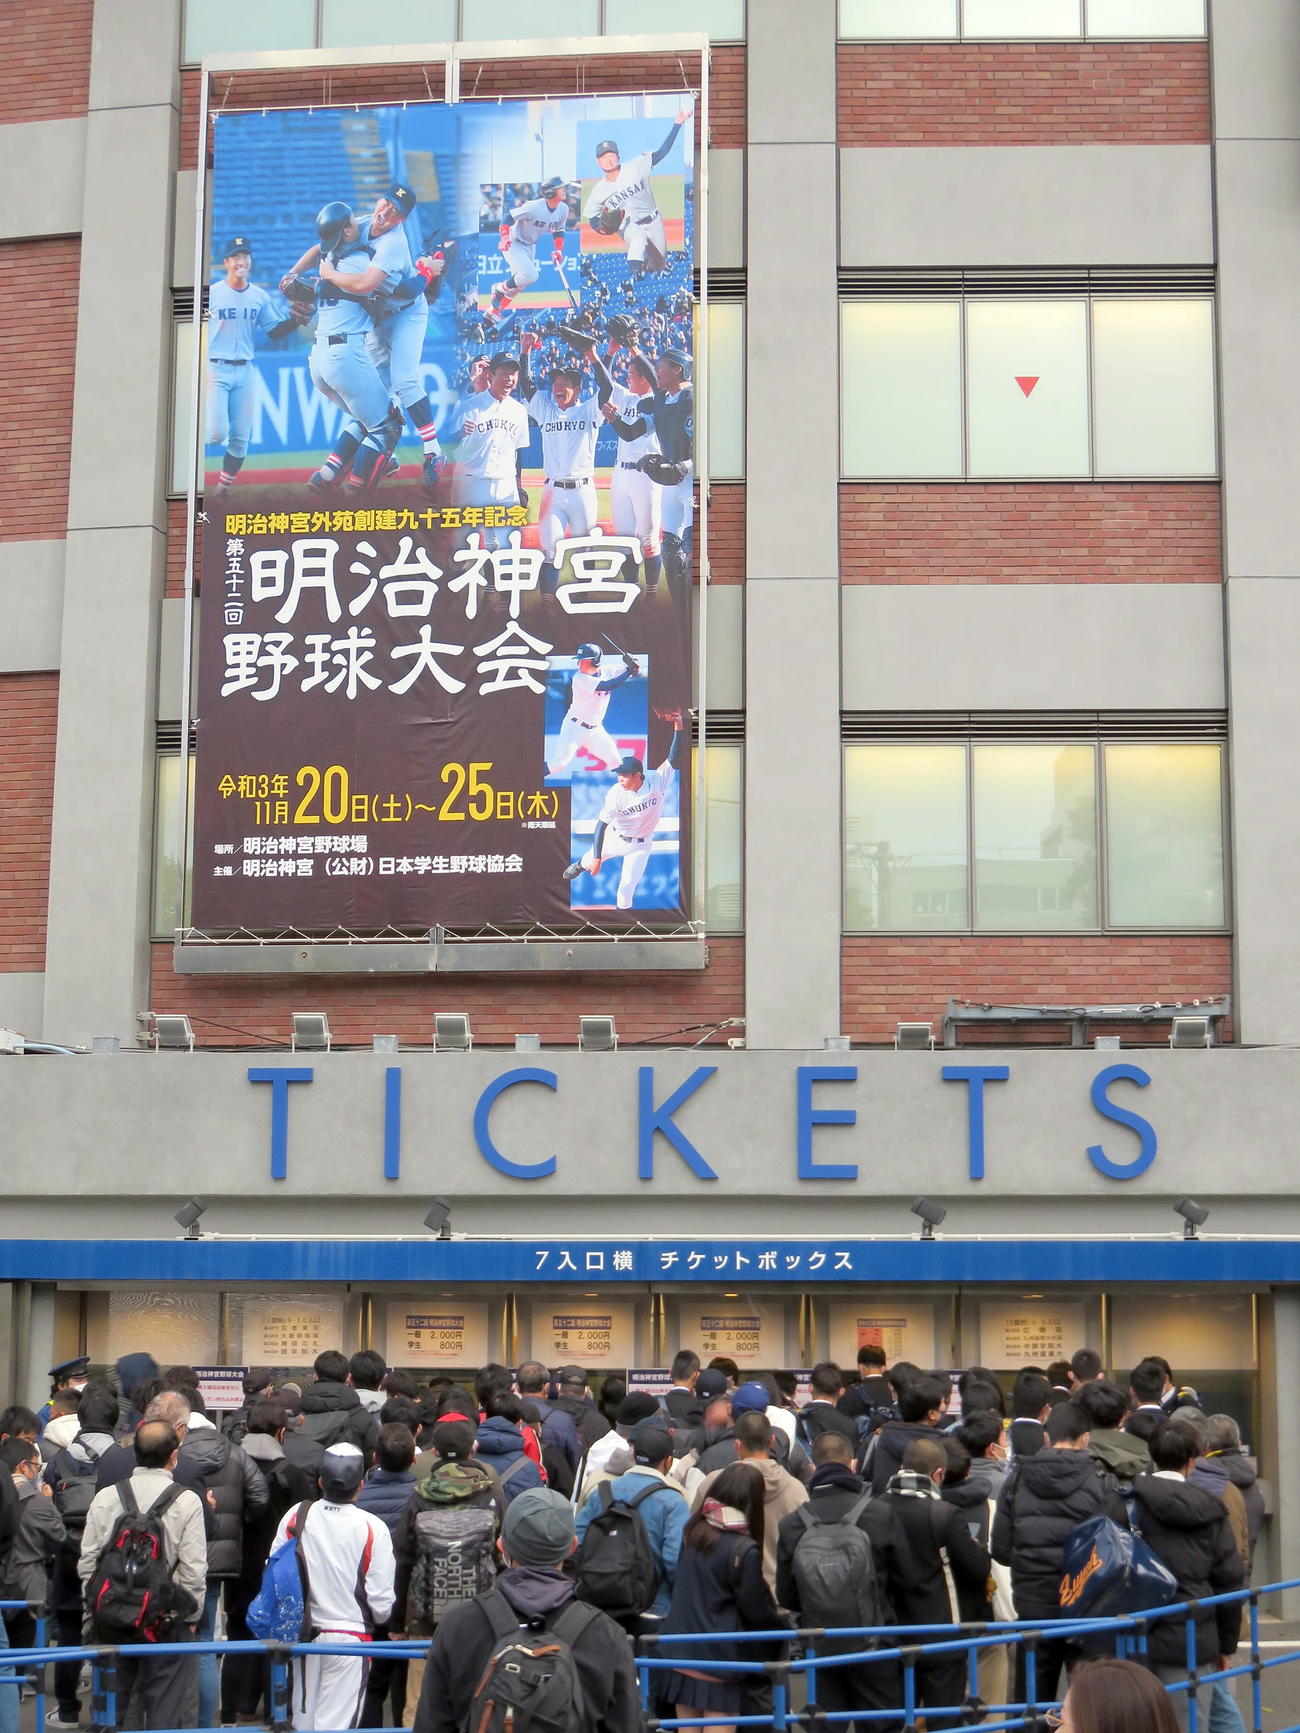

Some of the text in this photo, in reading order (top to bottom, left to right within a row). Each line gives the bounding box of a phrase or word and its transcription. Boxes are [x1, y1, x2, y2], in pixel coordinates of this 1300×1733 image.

[545, 420, 585, 433] CHUKYO
[225, 505, 528, 535] 明治神宮外苑創建九十五年記念
[224, 537, 245, 625] 第五十二回
[249, 527, 643, 624] 明治神宮
[221, 620, 554, 700] 野球大会
[217, 773, 289, 798] 令和3年
[254, 801, 289, 824] 11月
[247, 1064, 1157, 1179] TICKETS
[535, 1251, 853, 1271] 7入口横 チケットボックス
[434, 1557, 448, 1600] FACE
[448, 1541, 462, 1600] NORTH
[462, 1565, 476, 1598] THE
